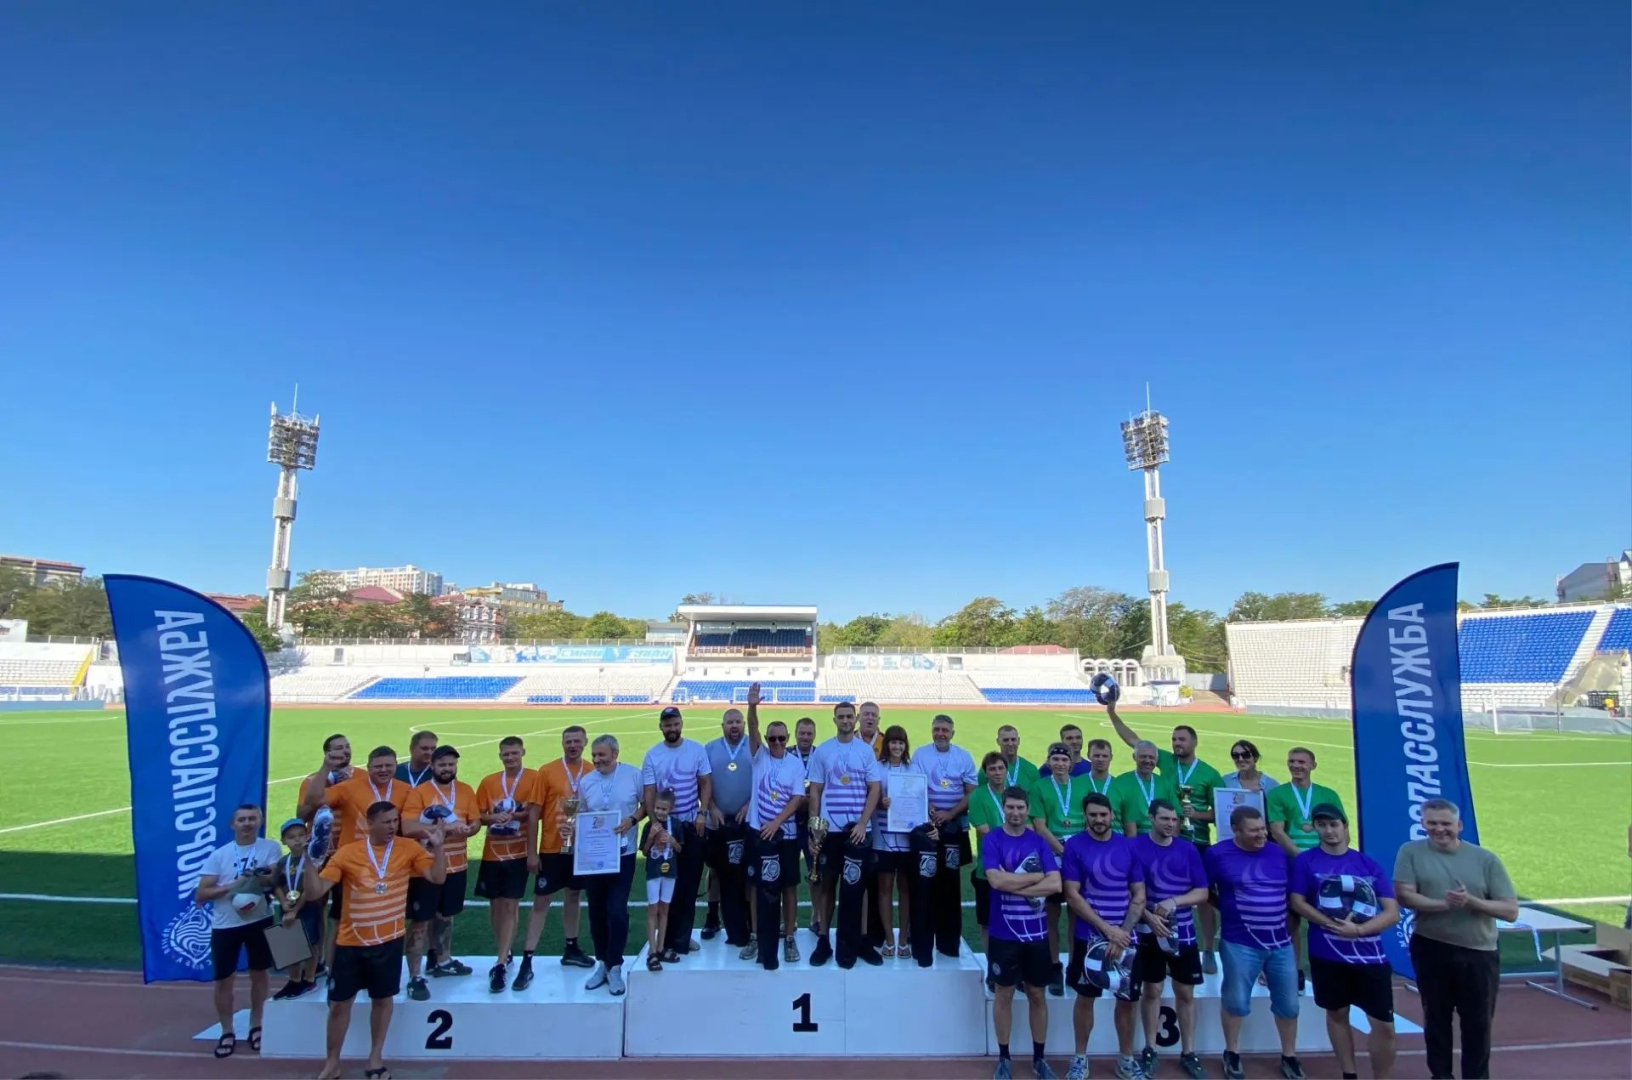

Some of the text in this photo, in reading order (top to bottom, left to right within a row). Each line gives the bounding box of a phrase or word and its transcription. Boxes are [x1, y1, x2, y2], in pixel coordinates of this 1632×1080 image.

[425, 1009, 453, 1049] 2
[793, 993, 818, 1032] 1
[1156, 1006, 1180, 1047] 3
